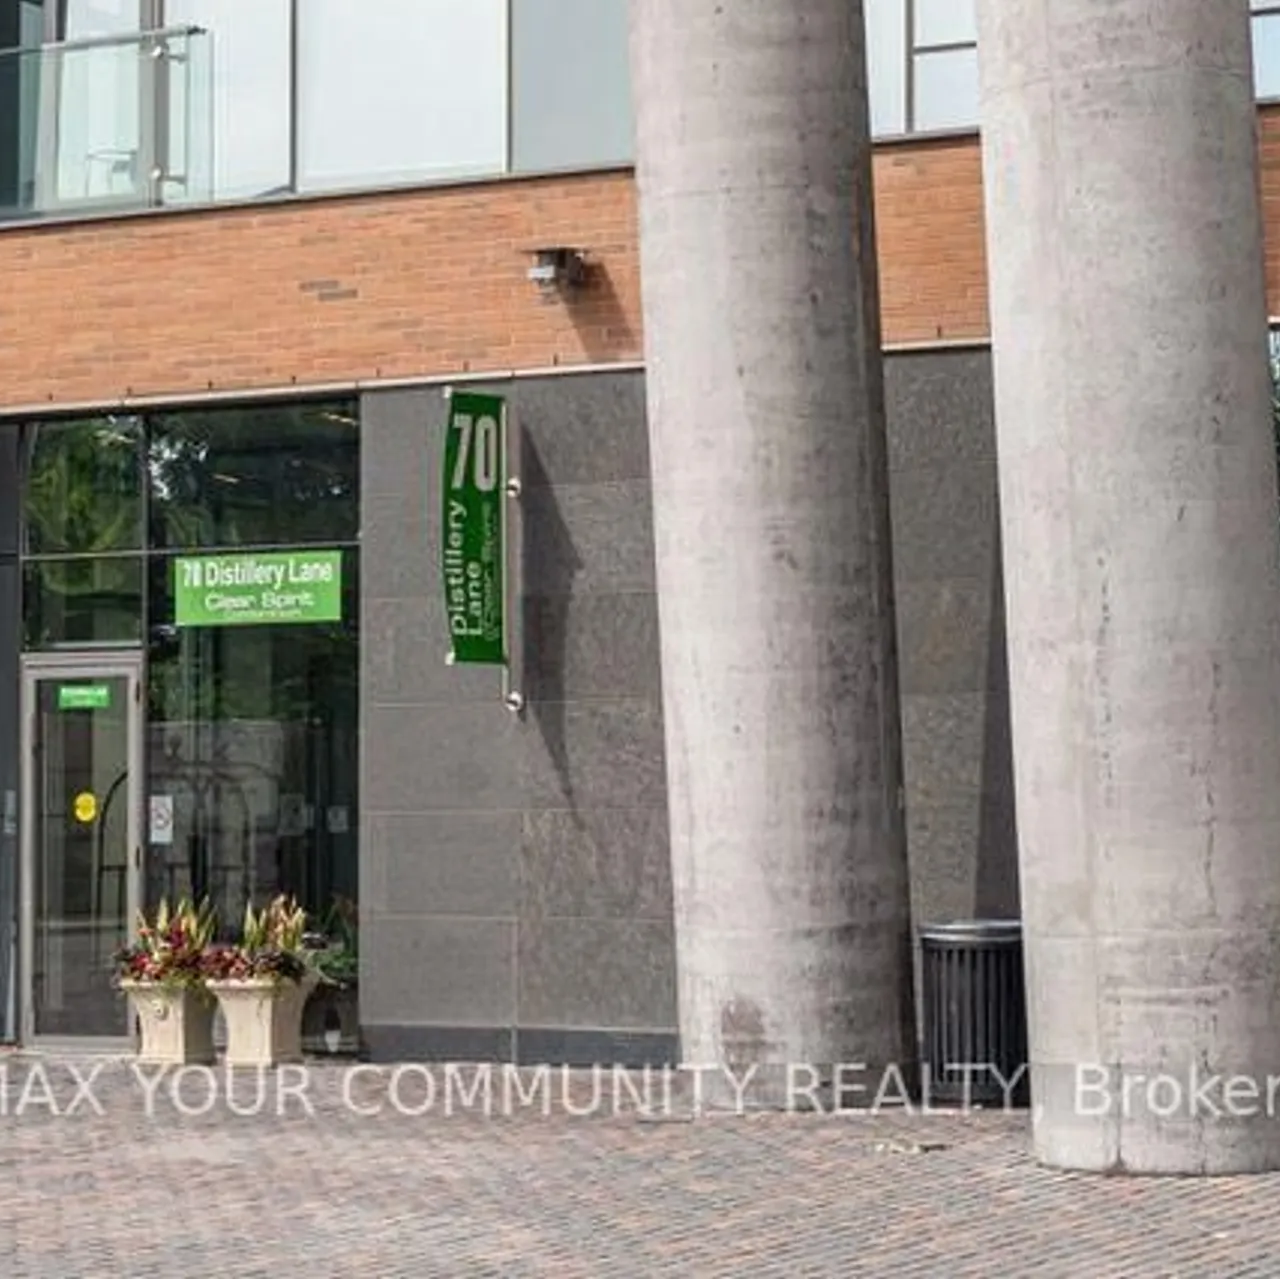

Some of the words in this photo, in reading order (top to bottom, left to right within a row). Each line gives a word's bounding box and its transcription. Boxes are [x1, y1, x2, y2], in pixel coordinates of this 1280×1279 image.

[452, 412, 498, 492] 70
[205, 561, 286, 590] Distillery
[289, 559, 333, 582] Lane
[445, 501, 468, 636] Distillery
[466, 560, 484, 636] Lane
